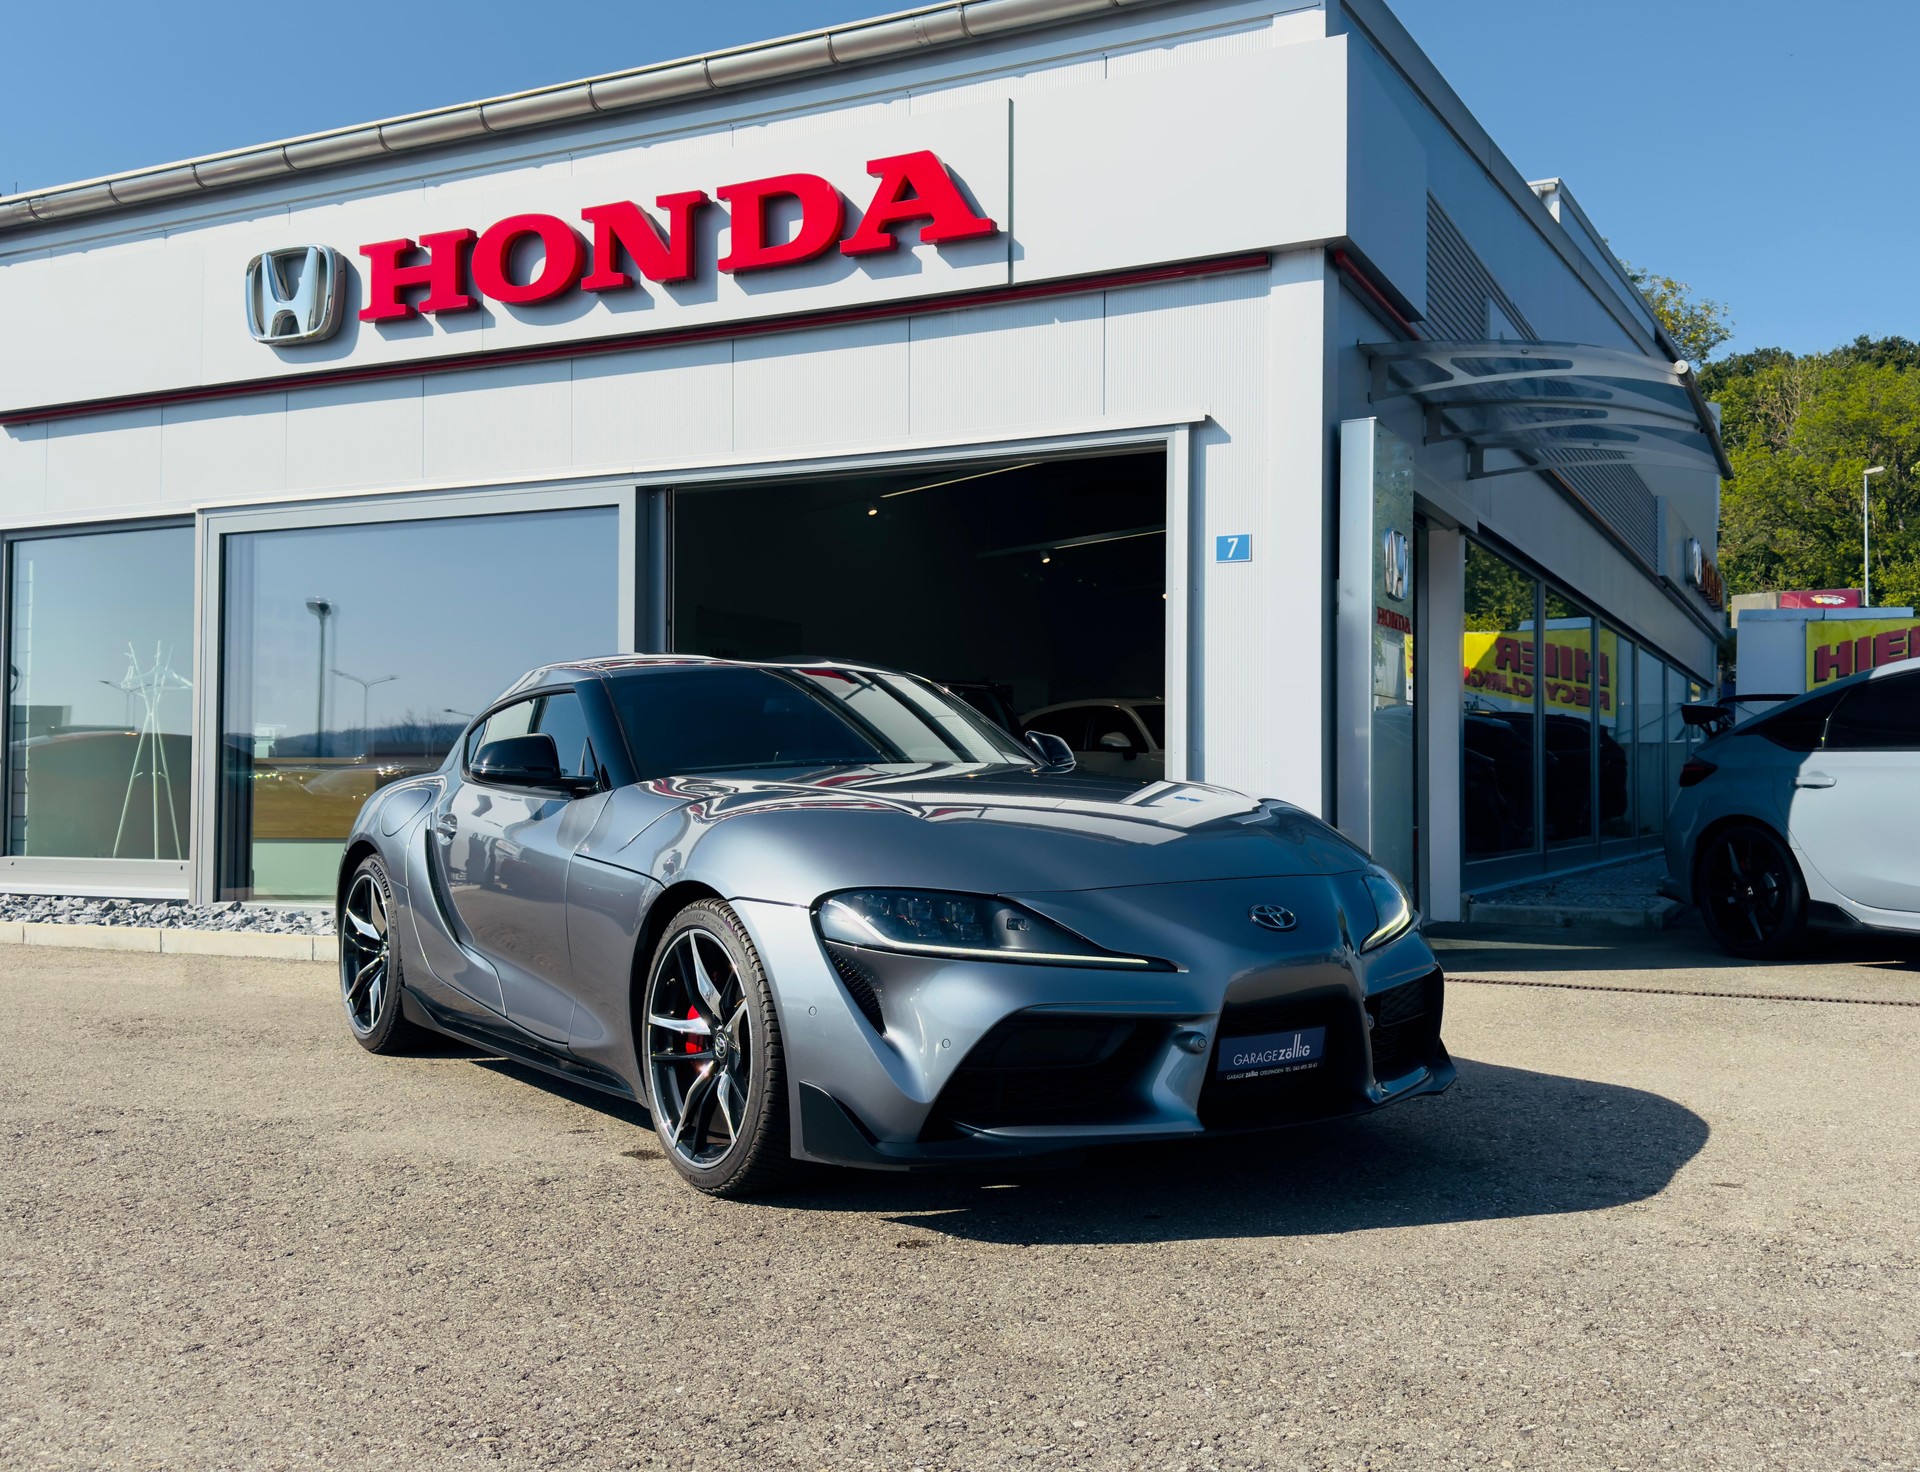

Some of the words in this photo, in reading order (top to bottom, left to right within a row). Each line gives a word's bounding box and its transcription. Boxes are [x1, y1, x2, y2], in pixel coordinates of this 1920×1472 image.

[358, 150, 1000, 323] HONDA
[1227, 537, 1239, 559] 7
[1376, 606, 1412, 635] HONDA
[1226, 1073, 1245, 1081] GARAGE
